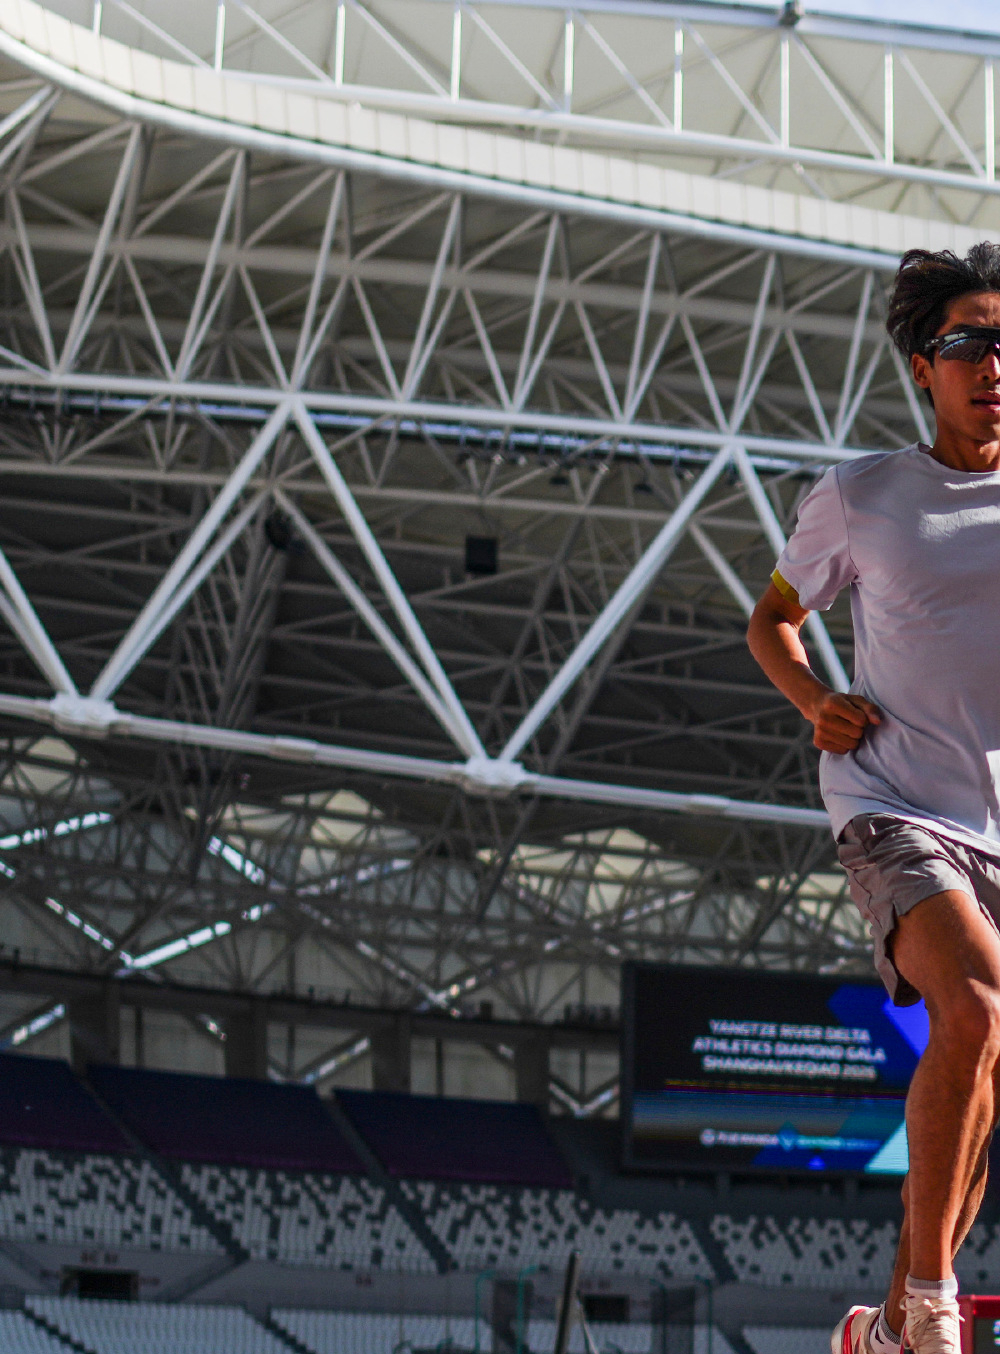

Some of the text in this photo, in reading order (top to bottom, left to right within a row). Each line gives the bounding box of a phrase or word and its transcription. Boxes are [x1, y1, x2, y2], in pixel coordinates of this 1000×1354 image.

[708, 1020, 871, 1044] YANGTZE RIVER DELTA
[693, 1036, 886, 1063] ATHLETICS DIAMOND GALA
